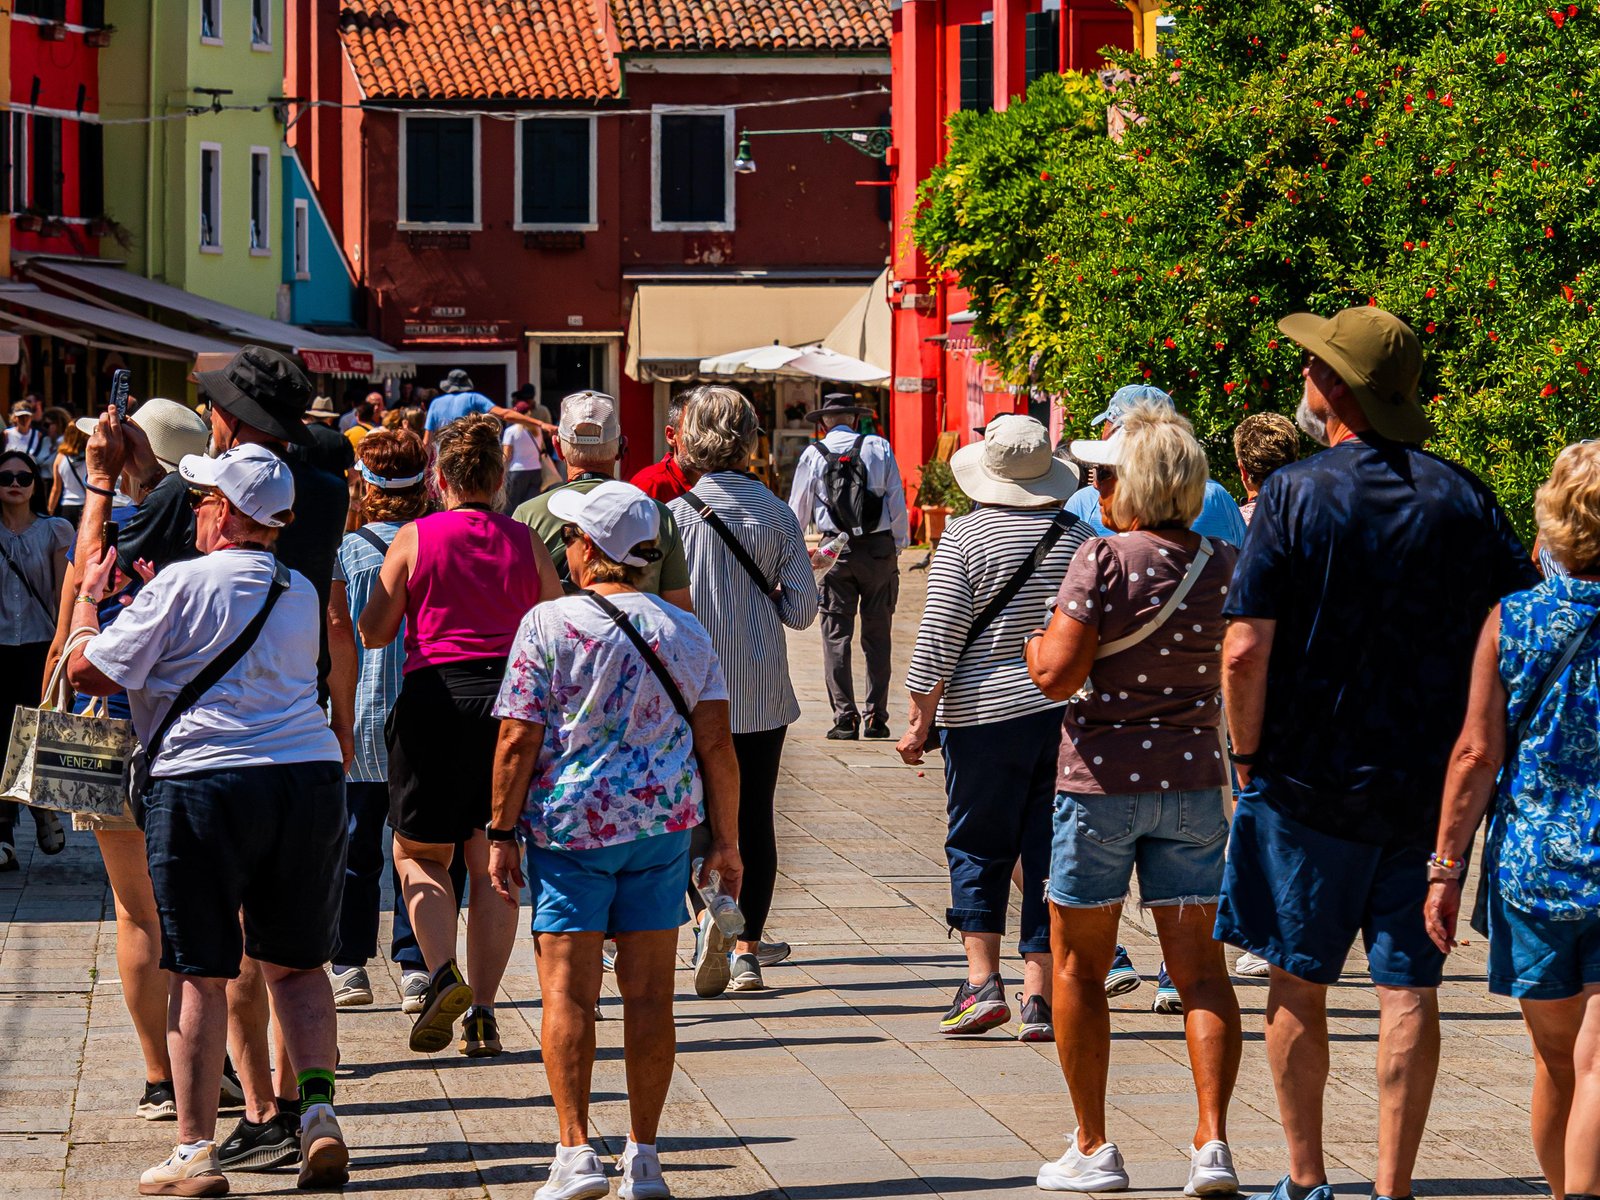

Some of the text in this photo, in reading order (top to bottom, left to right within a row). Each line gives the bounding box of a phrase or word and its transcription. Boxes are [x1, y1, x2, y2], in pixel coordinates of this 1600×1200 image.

[181, 465, 196, 479] ITALIA
[60, 754, 103, 771] VENEZIA
[960, 994, 977, 1012] HOKA
